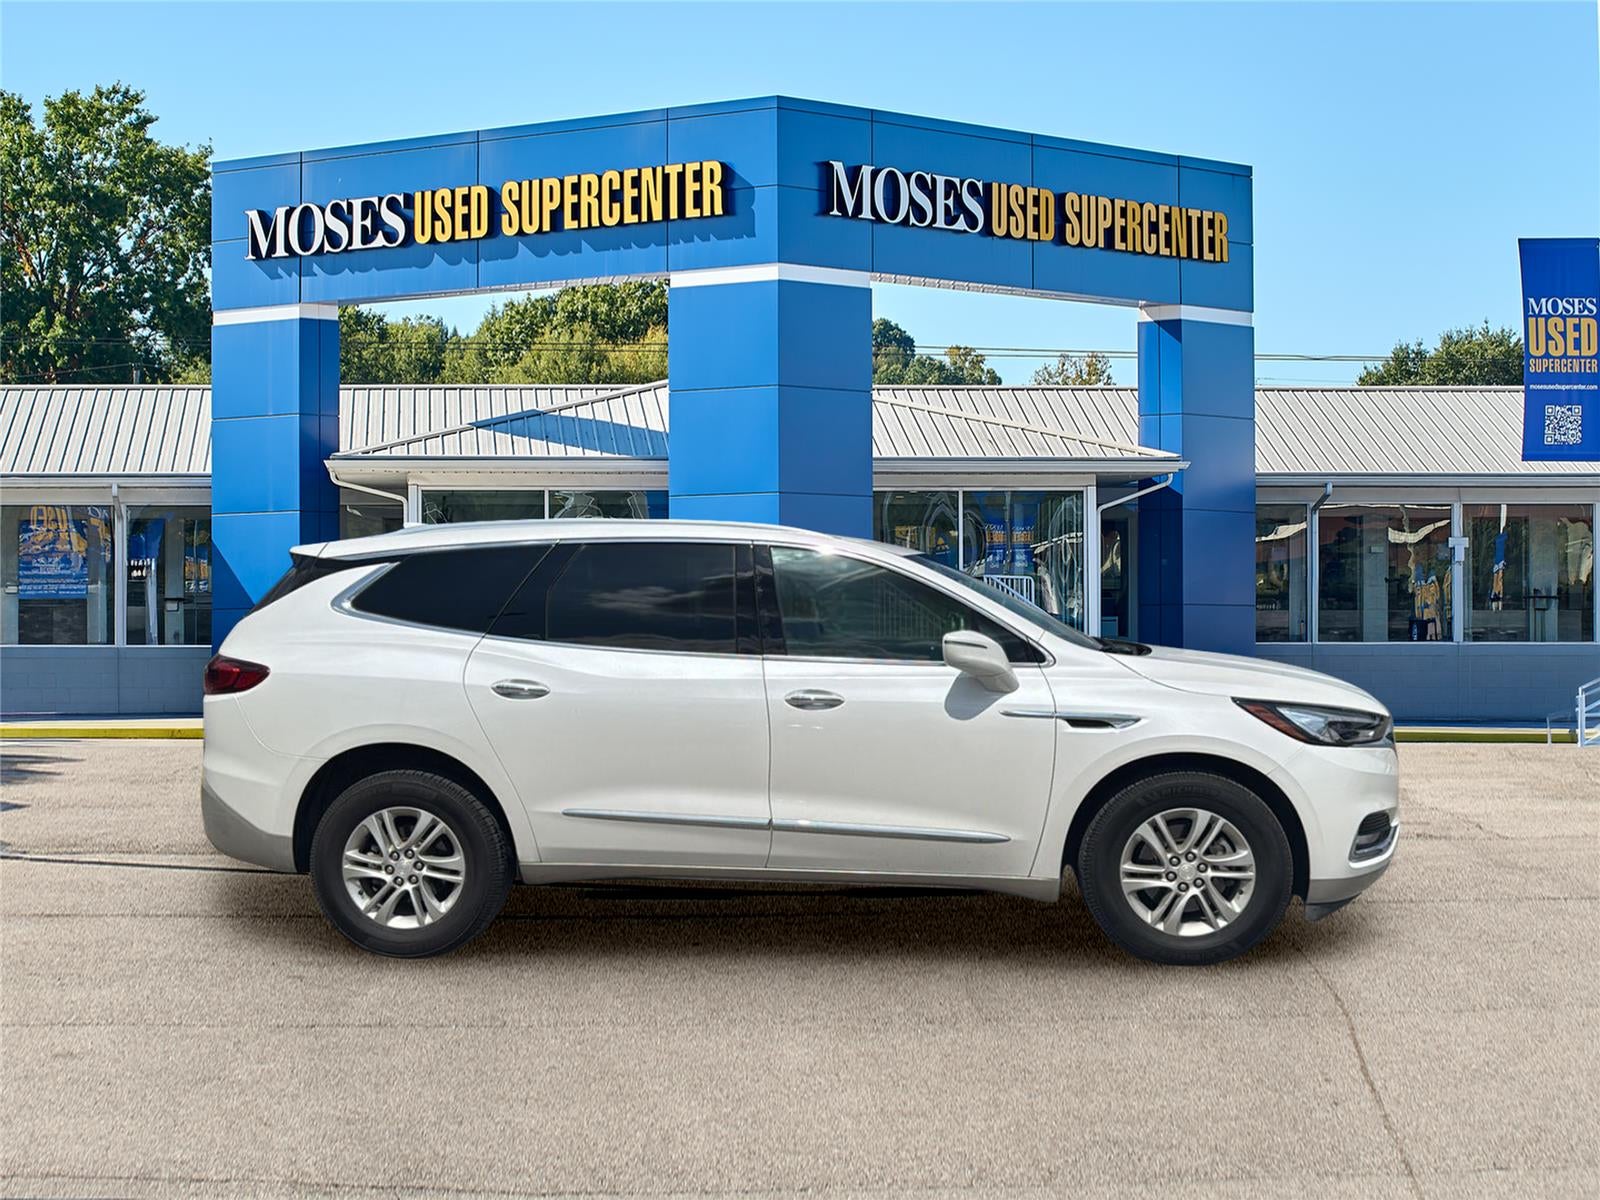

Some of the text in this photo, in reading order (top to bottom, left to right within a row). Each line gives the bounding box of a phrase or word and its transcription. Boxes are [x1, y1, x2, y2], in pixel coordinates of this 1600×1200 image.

[244, 160, 724, 262] MOSES USED SUPERCENTER
[829, 160, 1230, 264] MOSES USED SUPERCENTER
[1528, 297, 1597, 316] MOSES
[1528, 316, 1598, 357] USED
[1529, 358, 1598, 374] SUPERCENTER
